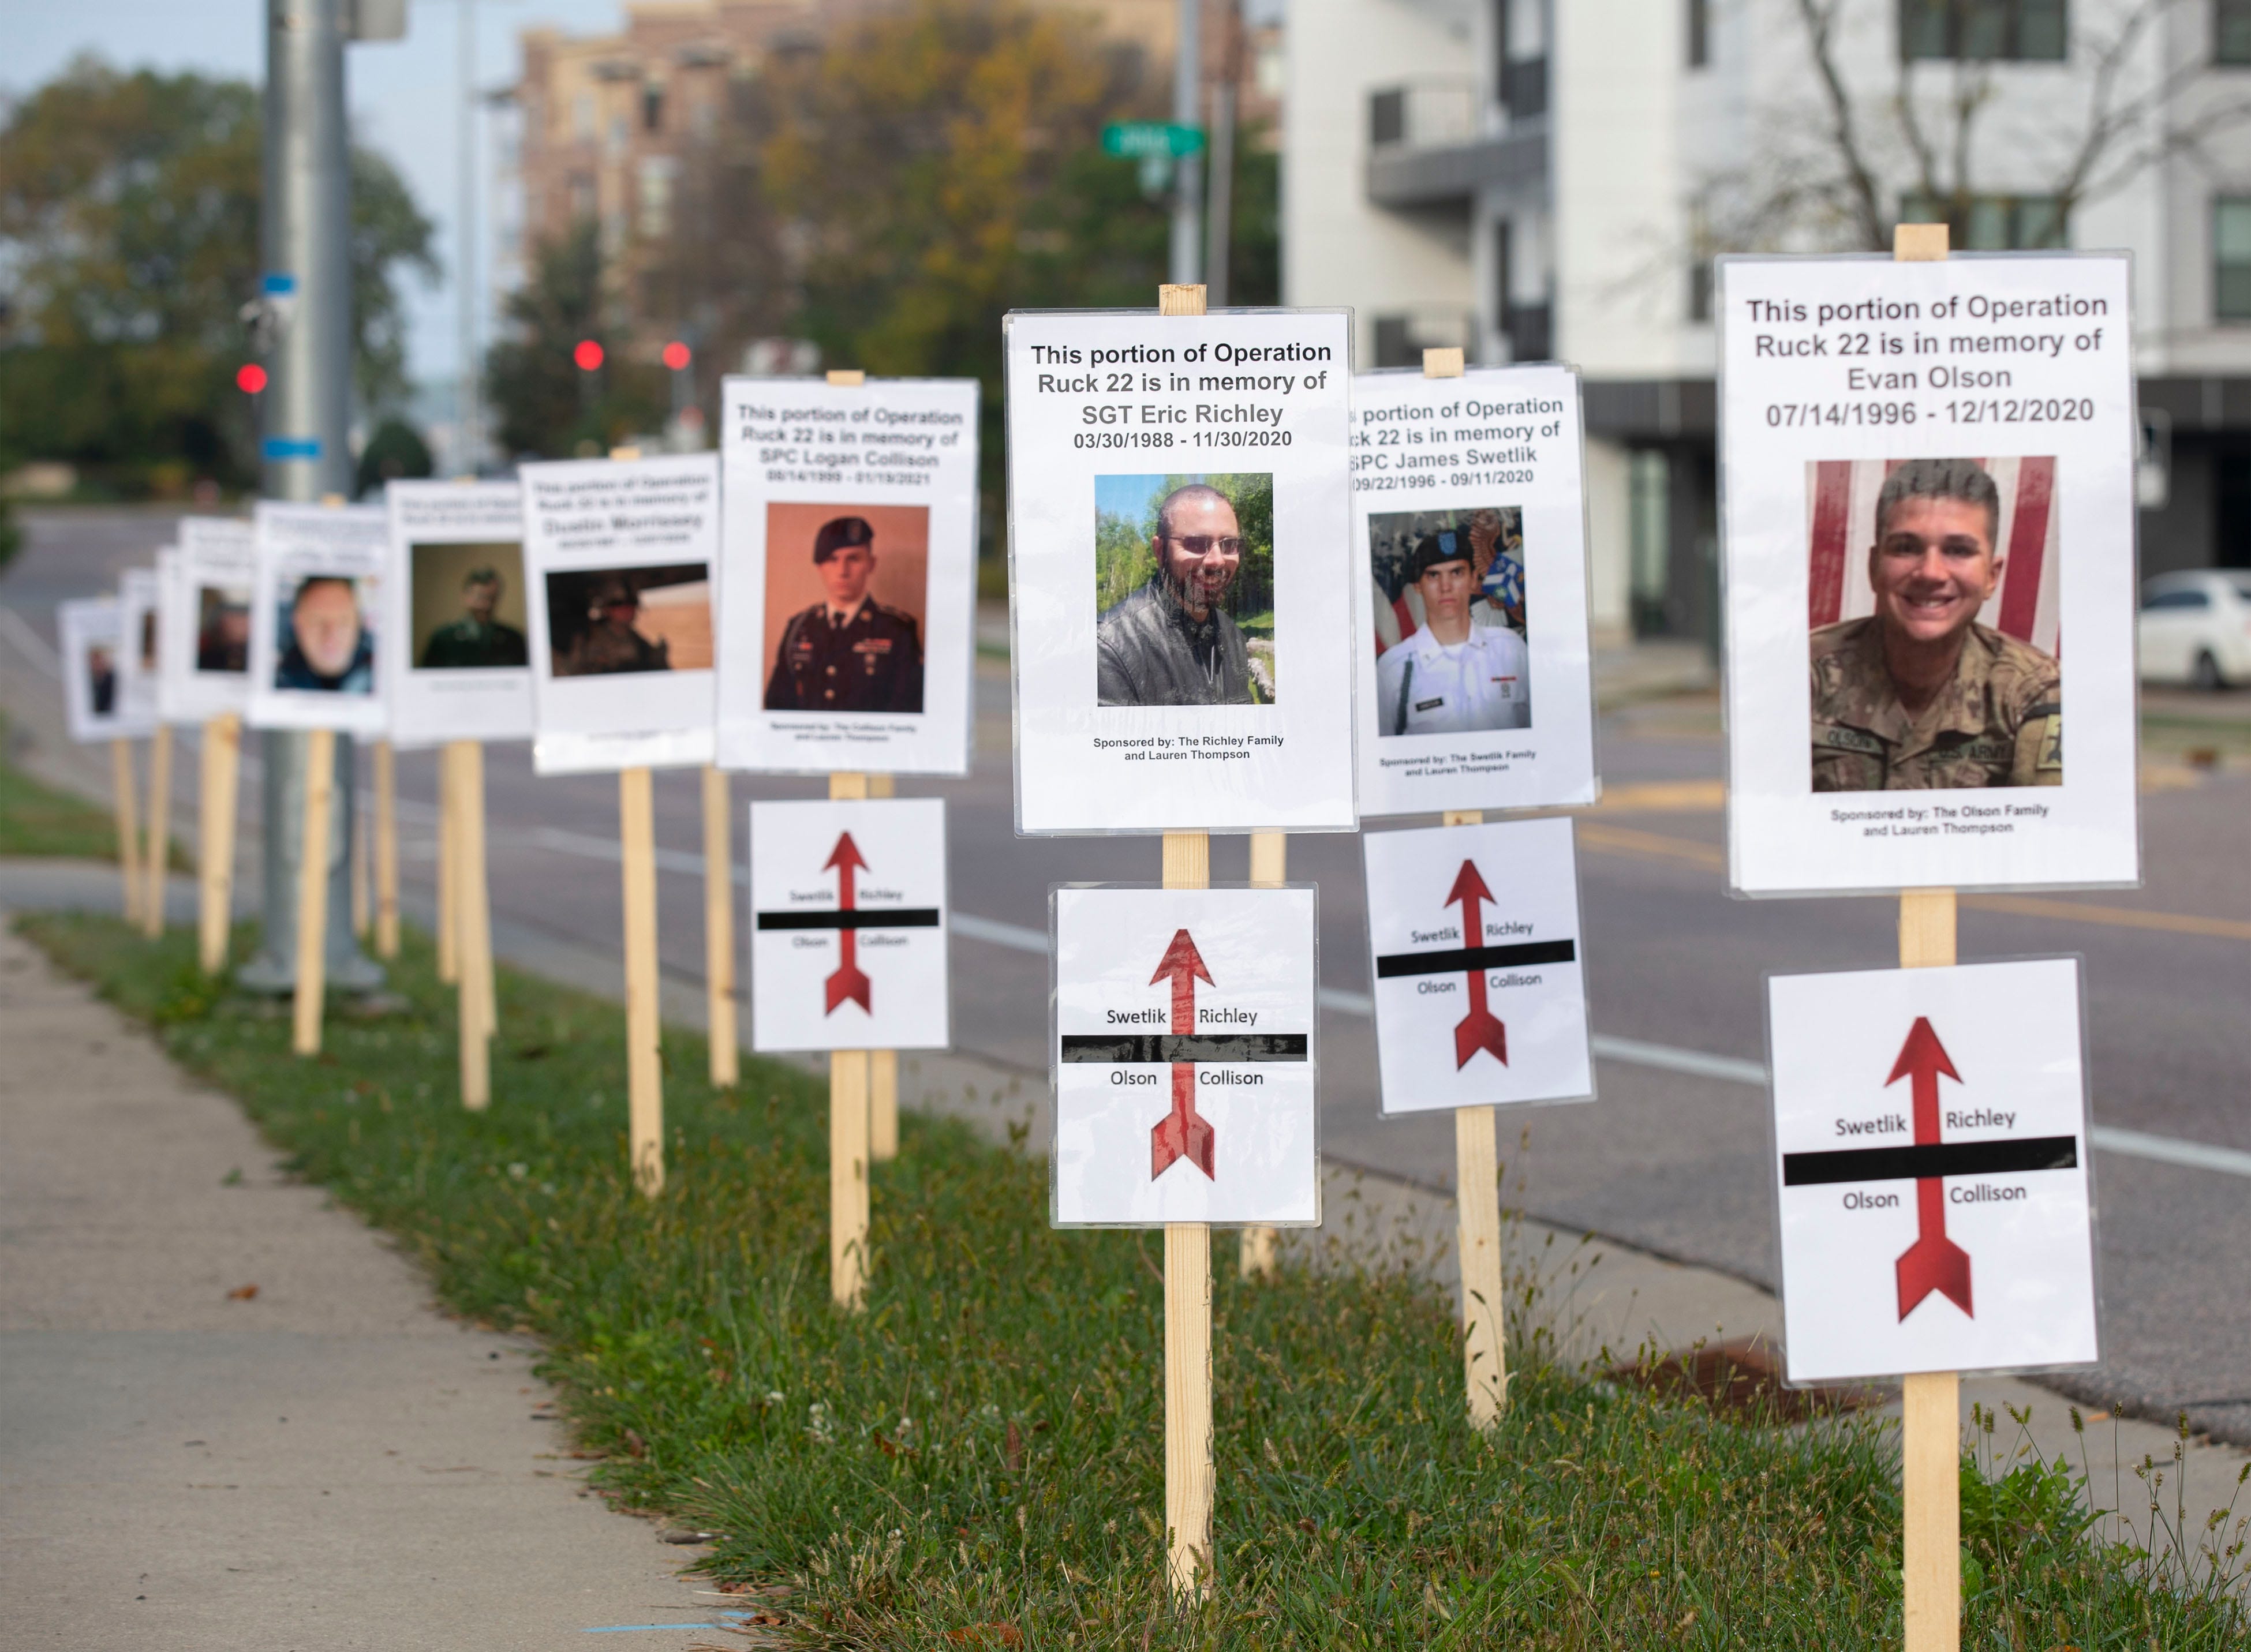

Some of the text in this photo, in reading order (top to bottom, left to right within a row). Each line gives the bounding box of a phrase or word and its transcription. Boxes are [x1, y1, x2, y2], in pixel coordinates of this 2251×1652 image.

[1747, 294, 2107, 327] This portion of Operation
[1756, 328, 2102, 357] Ruck 22 is in memory of
[1031, 343, 1330, 368] This portion of Operation
[1039, 370, 1327, 395] Ruck 22 is in memory of
[1848, 366, 2011, 390] Evan Olson
[739, 404, 963, 426] This portion of Operation
[1083, 404, 1283, 427] SGT Eric Richley
[1363, 404, 1433, 426] portion
[1441, 402, 1459, 418] of
[1466, 398, 1563, 419] Operation
[1767, 402, 1916, 427] 07/14/1996
[1946, 398, 2093, 423] 12/12/2020
[742, 426, 959, 449] Ruck 22 is in memory of
[1074, 433, 1173, 448] 03/30/1988
[1194, 431, 1291, 447] 11/30/2020
[1378, 429, 1400, 445] 22
[1407, 428, 1423, 444] is
[1430, 428, 1447, 443] in
[1454, 426, 1534, 442] memory
[1541, 421, 1560, 437] of
[760, 448, 939, 469] SPC Logan Collison
[1396, 453, 1459, 469] James
[1467, 447, 1536, 465] Swetlik
[1451, 469, 1534, 486] 09/11/2020
[1094, 736, 1284, 749] Sponsored by: The Richley Family
[1125, 750, 1250, 761] and Lauren Thompson
[1380, 756, 1430, 767] Sponsored
[1451, 754, 1467, 762] The
[1505, 750, 1536, 759] Family
[1424, 767, 1458, 776] Lauren
[1460, 764, 1509, 773] Thompson
[1831, 808, 1904, 823] Sponsored
[1933, 807, 1957, 818] The
[1961, 806, 2001, 817] Olson
[2005, 804, 2049, 818] Family
[1863, 822, 2014, 837] and Lauren Thompson
[790, 890, 903, 901] Swetlik Richley
[792, 935, 908, 948] Olson Collison
[1412, 922, 1533, 943] Swetlik Richley
[1418, 975, 1542, 994] Olson Collison
[1107, 1008, 1257, 1026] Swetlik Richley
[1111, 1070, 1263, 1085] Olson Collison
[1836, 1109, 2016, 1135] Swetlik Richley
[1844, 1185, 2026, 1209] Olson Collison
